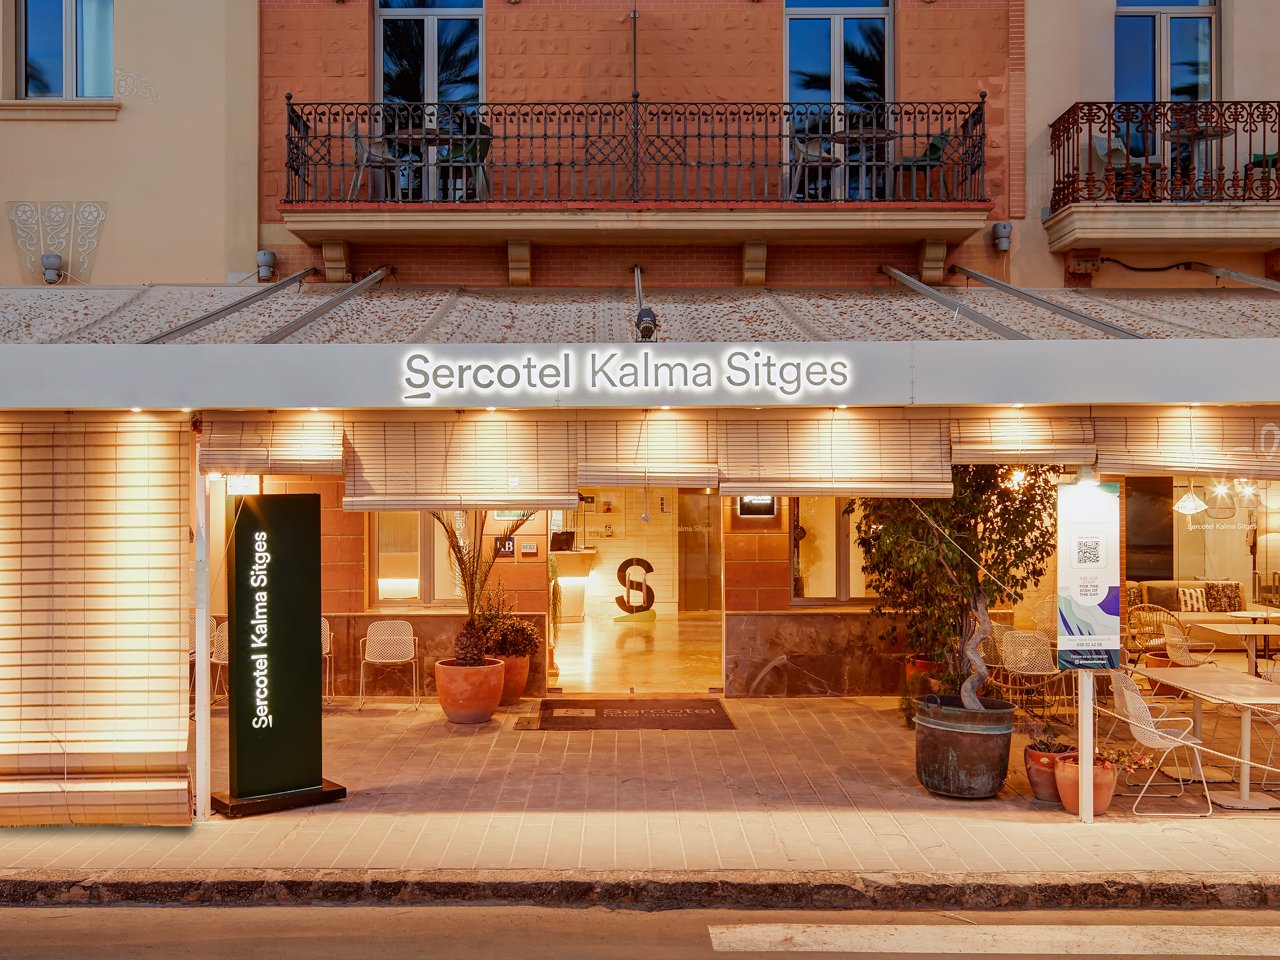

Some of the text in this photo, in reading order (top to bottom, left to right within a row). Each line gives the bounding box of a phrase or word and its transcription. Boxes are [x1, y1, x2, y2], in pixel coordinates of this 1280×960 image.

[404, 350, 849, 399] Sercotel Kalma Sitges
[1187, 523, 1215, 531] Sercotel
[1237, 523, 1256, 531] Sitges
[250, 531, 273, 729] Sercotel Kalma Sitges
